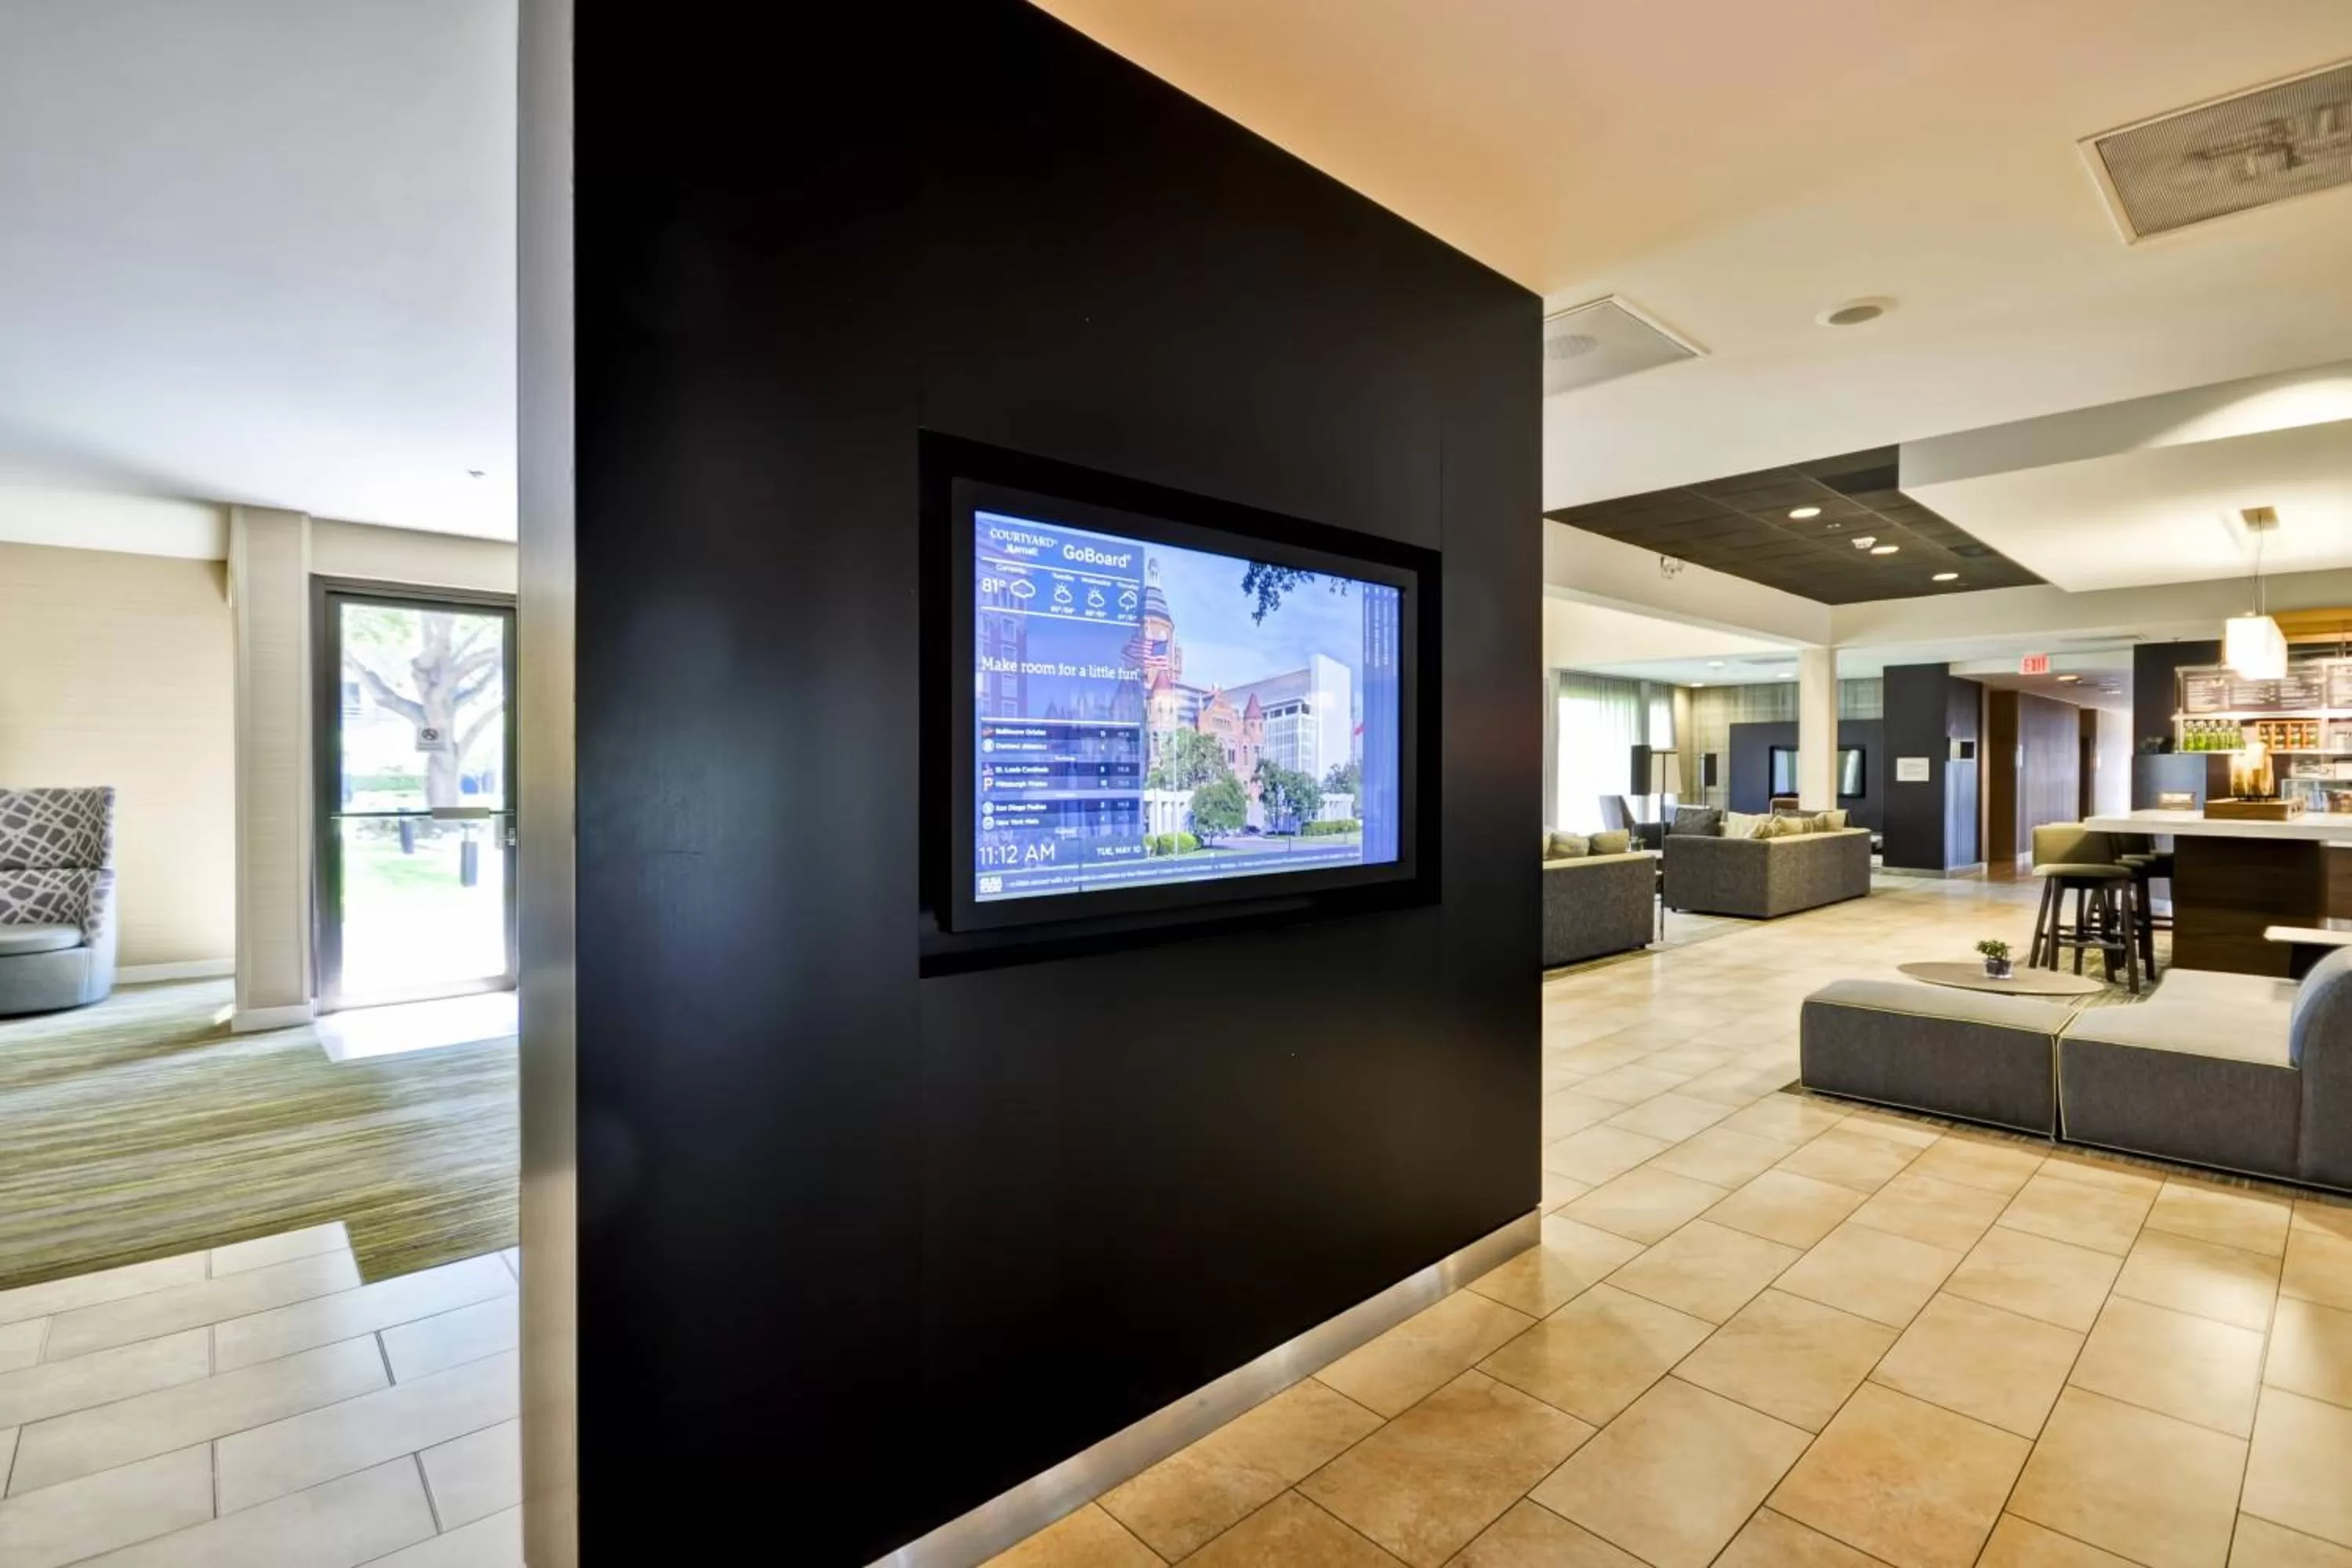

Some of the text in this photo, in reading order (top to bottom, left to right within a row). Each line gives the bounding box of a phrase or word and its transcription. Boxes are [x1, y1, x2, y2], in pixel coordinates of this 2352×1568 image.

[989, 528, 1057, 548] COURTYARD
[1063, 544, 1131, 568] GoBoard
[982, 655, 1018, 672] Make
[1021, 662, 1054, 675] room
[1059, 662, 1076, 677] for
[1079, 666, 1087, 677] a
[1089, 663, 1115, 679] little
[2023, 657, 2046, 673] EXIT
[978, 842, 1055, 866] 11:12 AM
